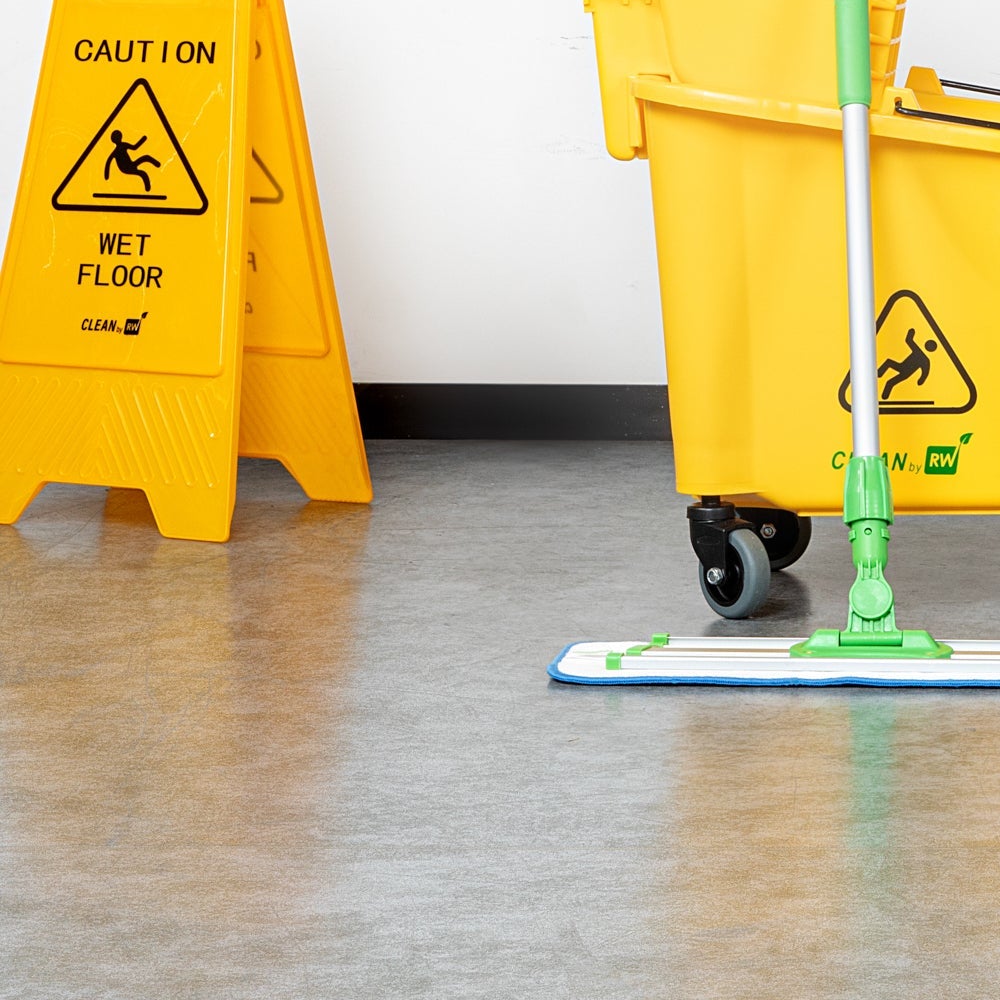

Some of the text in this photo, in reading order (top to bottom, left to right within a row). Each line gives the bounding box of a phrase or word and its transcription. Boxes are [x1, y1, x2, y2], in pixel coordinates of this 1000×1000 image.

[74, 39, 216, 64] CAUTION
[99, 233, 151, 256] WET
[77, 263, 163, 288] FLOOR
[81, 318, 117, 332] CLEAN
[125, 321, 140, 332] RW
[908, 461, 922, 474] by
[927, 451, 958, 470] RW
